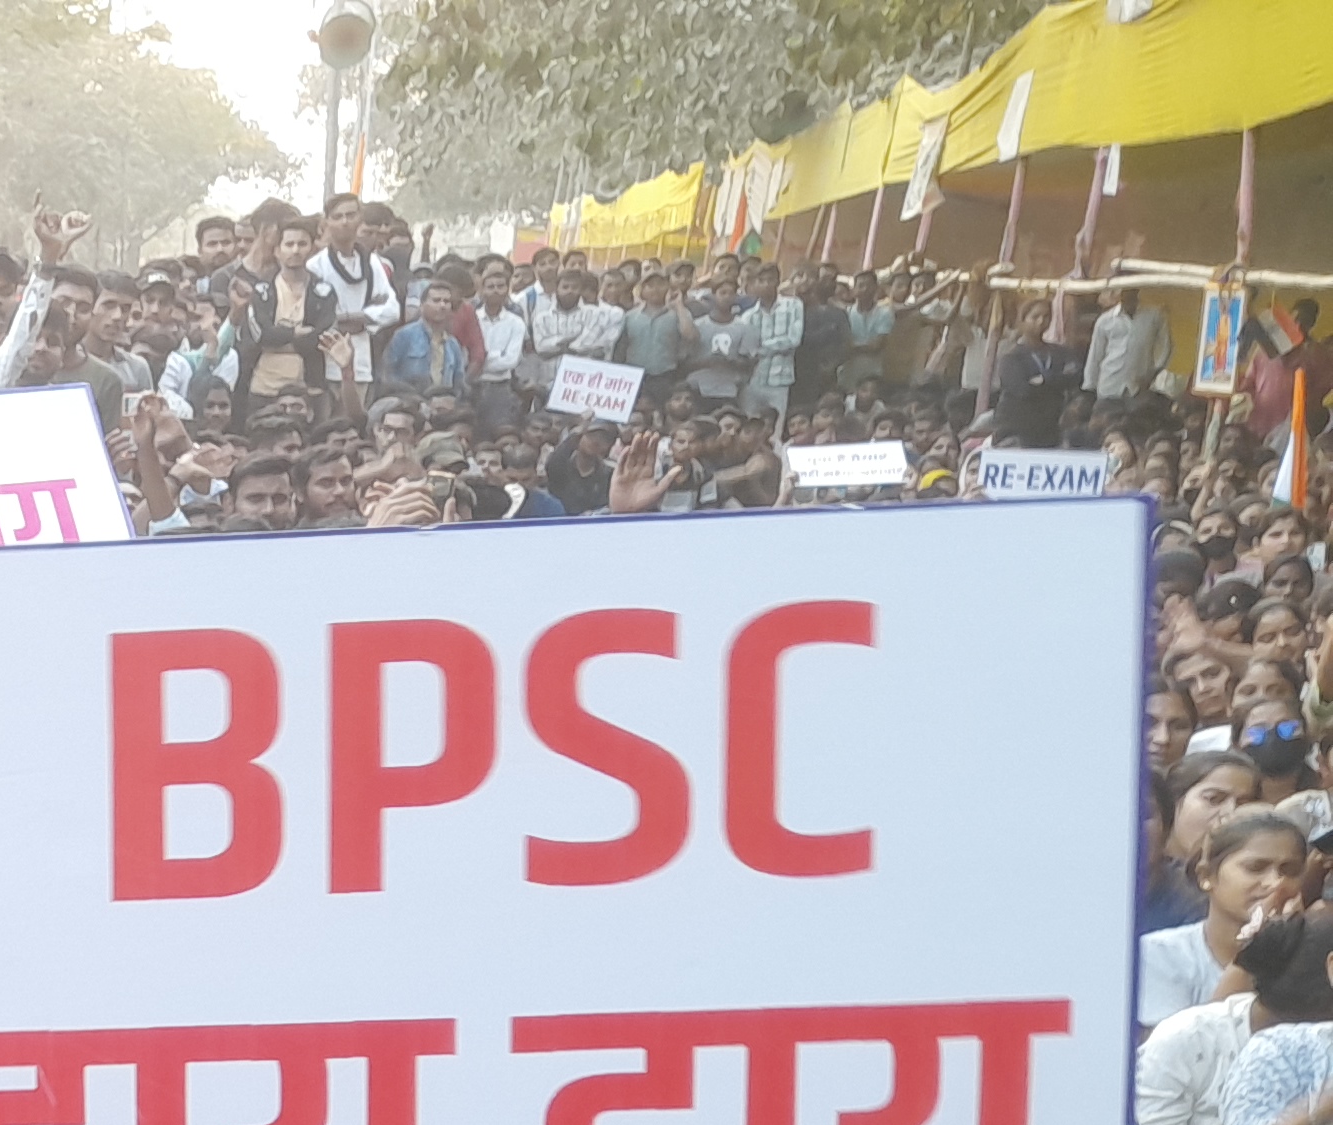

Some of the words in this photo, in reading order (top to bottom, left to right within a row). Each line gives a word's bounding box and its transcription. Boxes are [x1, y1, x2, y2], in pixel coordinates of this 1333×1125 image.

[561, 387, 626, 412] RE-EXAM
[984, 463, 1101, 495] RE-EXAM
[108, 600, 877, 902] BPSC
